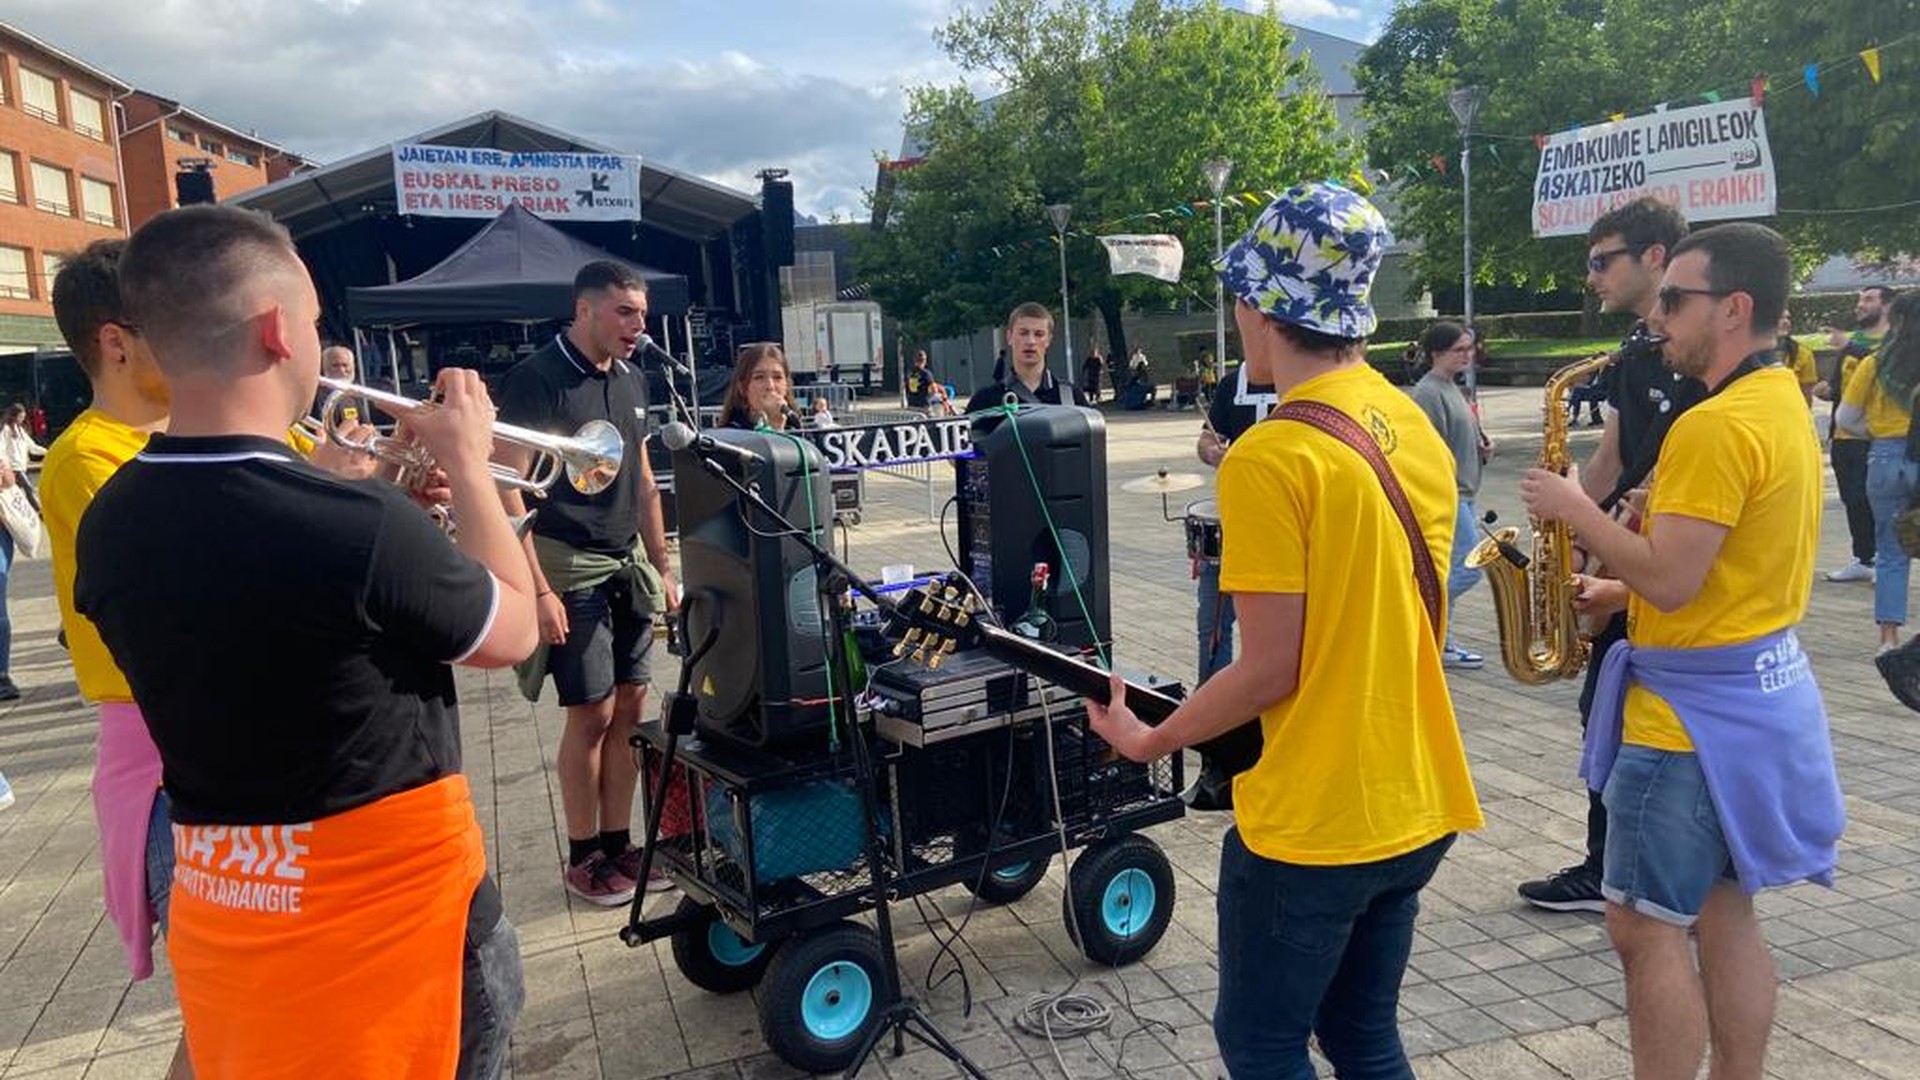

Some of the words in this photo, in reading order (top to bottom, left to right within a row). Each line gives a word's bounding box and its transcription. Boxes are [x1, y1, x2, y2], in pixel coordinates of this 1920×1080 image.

[398, 146, 469, 165] JAIETAN
[471, 150, 507, 168] ERE,
[508, 152, 584, 169] AMNISTIA
[586, 155, 624, 171] IPAR
[1541, 129, 1642, 174] EMAKUME
[1646, 110, 1759, 155] LANGILEOK
[402, 171, 486, 191] EUSKAL
[491, 175, 561, 193] PRESO
[1537, 160, 1646, 201] ASKATZEKO
[1687, 172, 1767, 208] ERAIKI!
[404, 192, 444, 210] ETA
[823, 419, 975, 468] SKAPAIE
